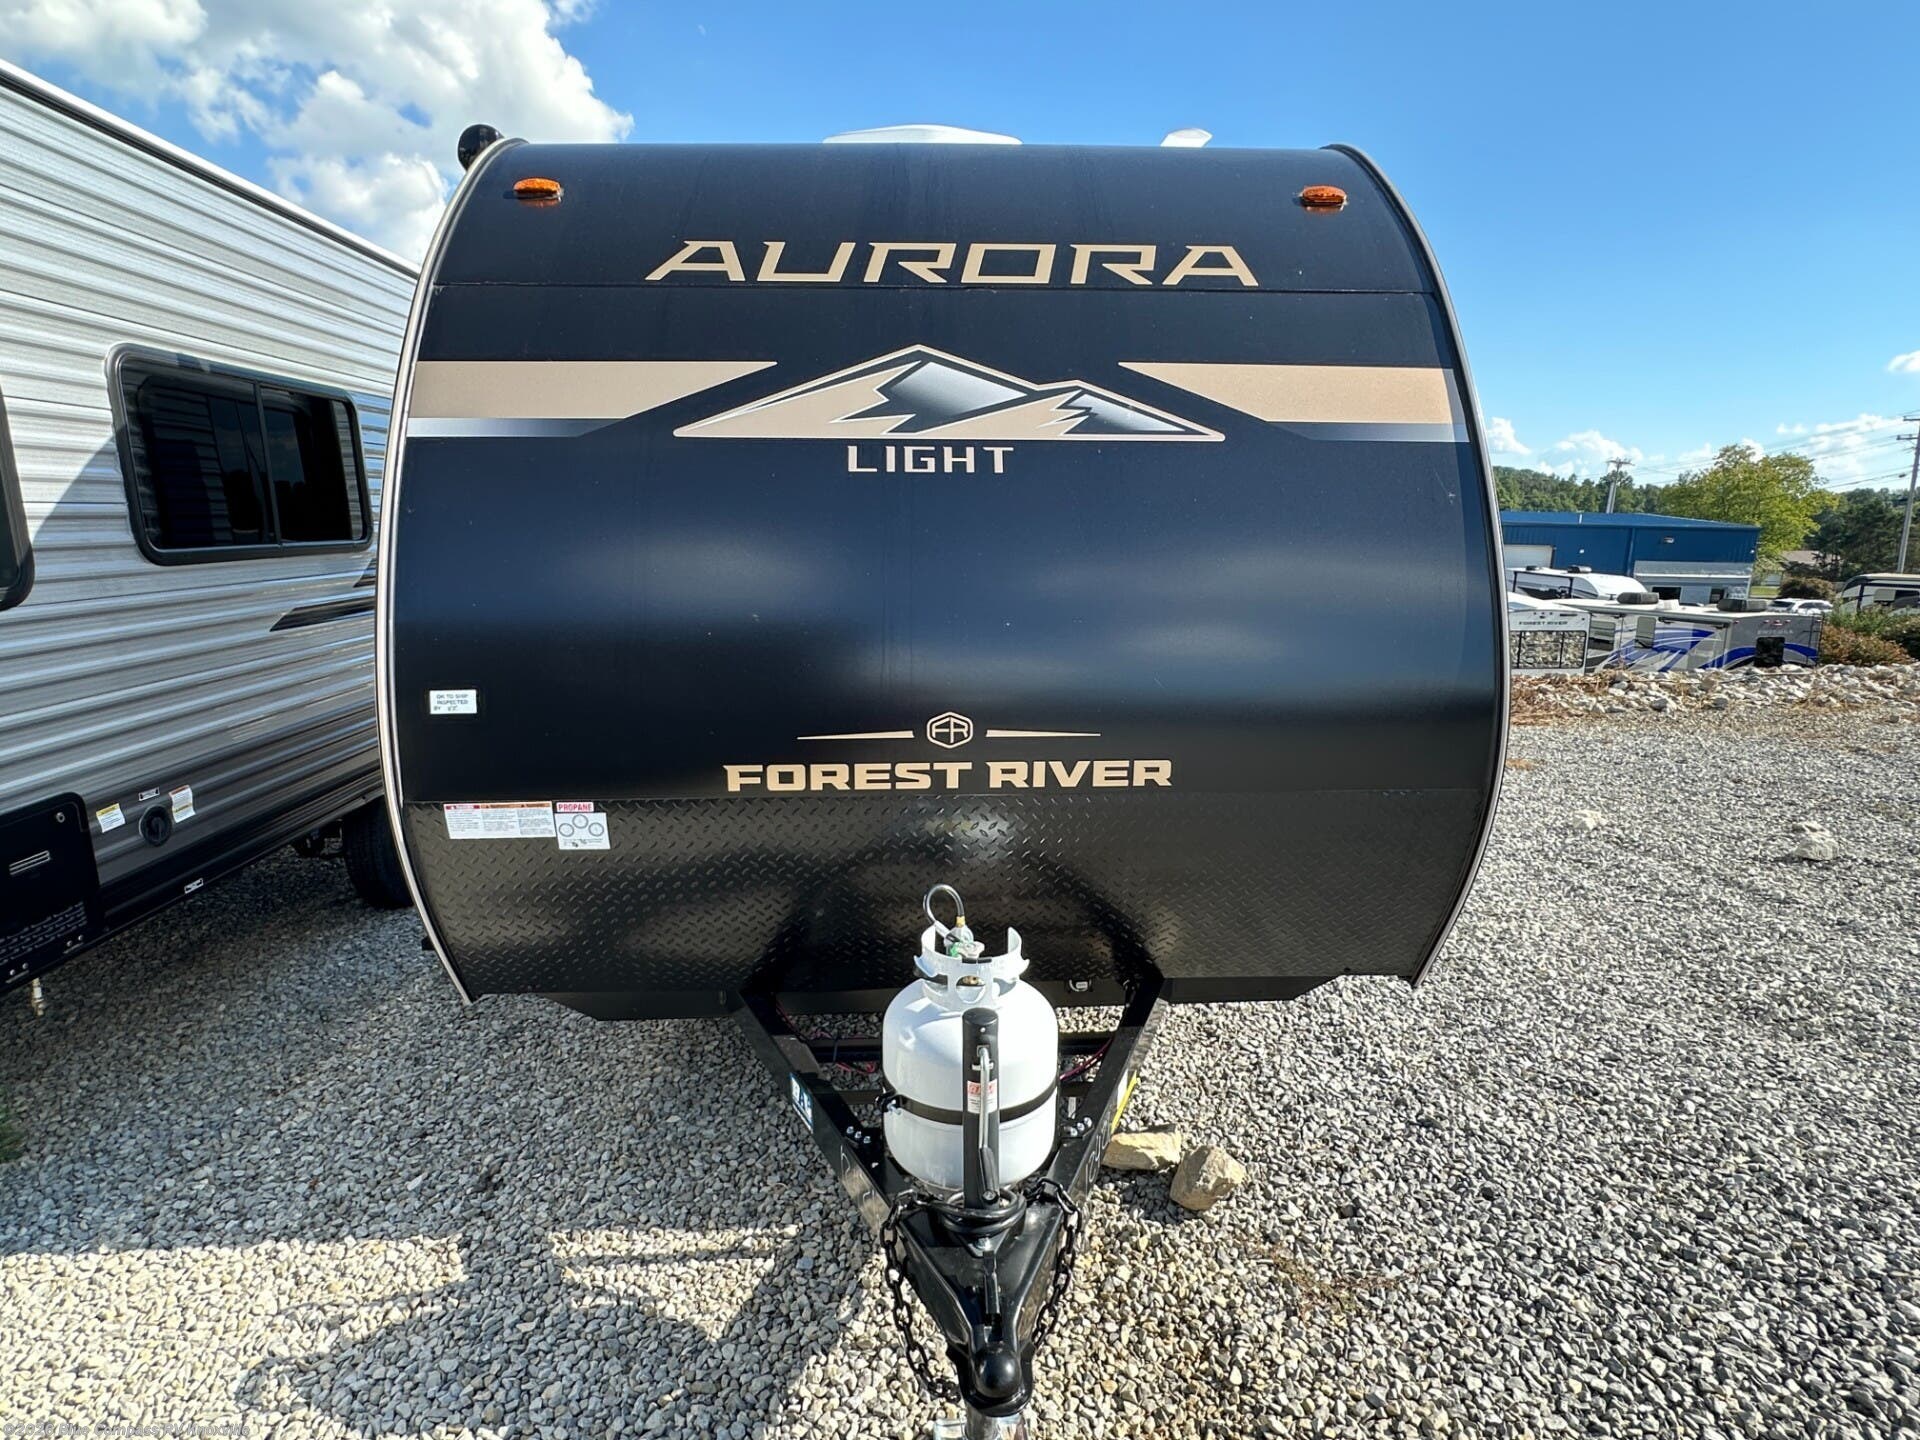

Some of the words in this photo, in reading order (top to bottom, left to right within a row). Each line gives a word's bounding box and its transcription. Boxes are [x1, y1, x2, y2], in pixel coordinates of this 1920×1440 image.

[645, 241, 1259, 287] AURORA
[847, 445, 1014, 474] LIGHT
[723, 761, 973, 792] FOREST
[985, 759, 1173, 789] RIVER
[558, 803, 592, 812] PROPANE
